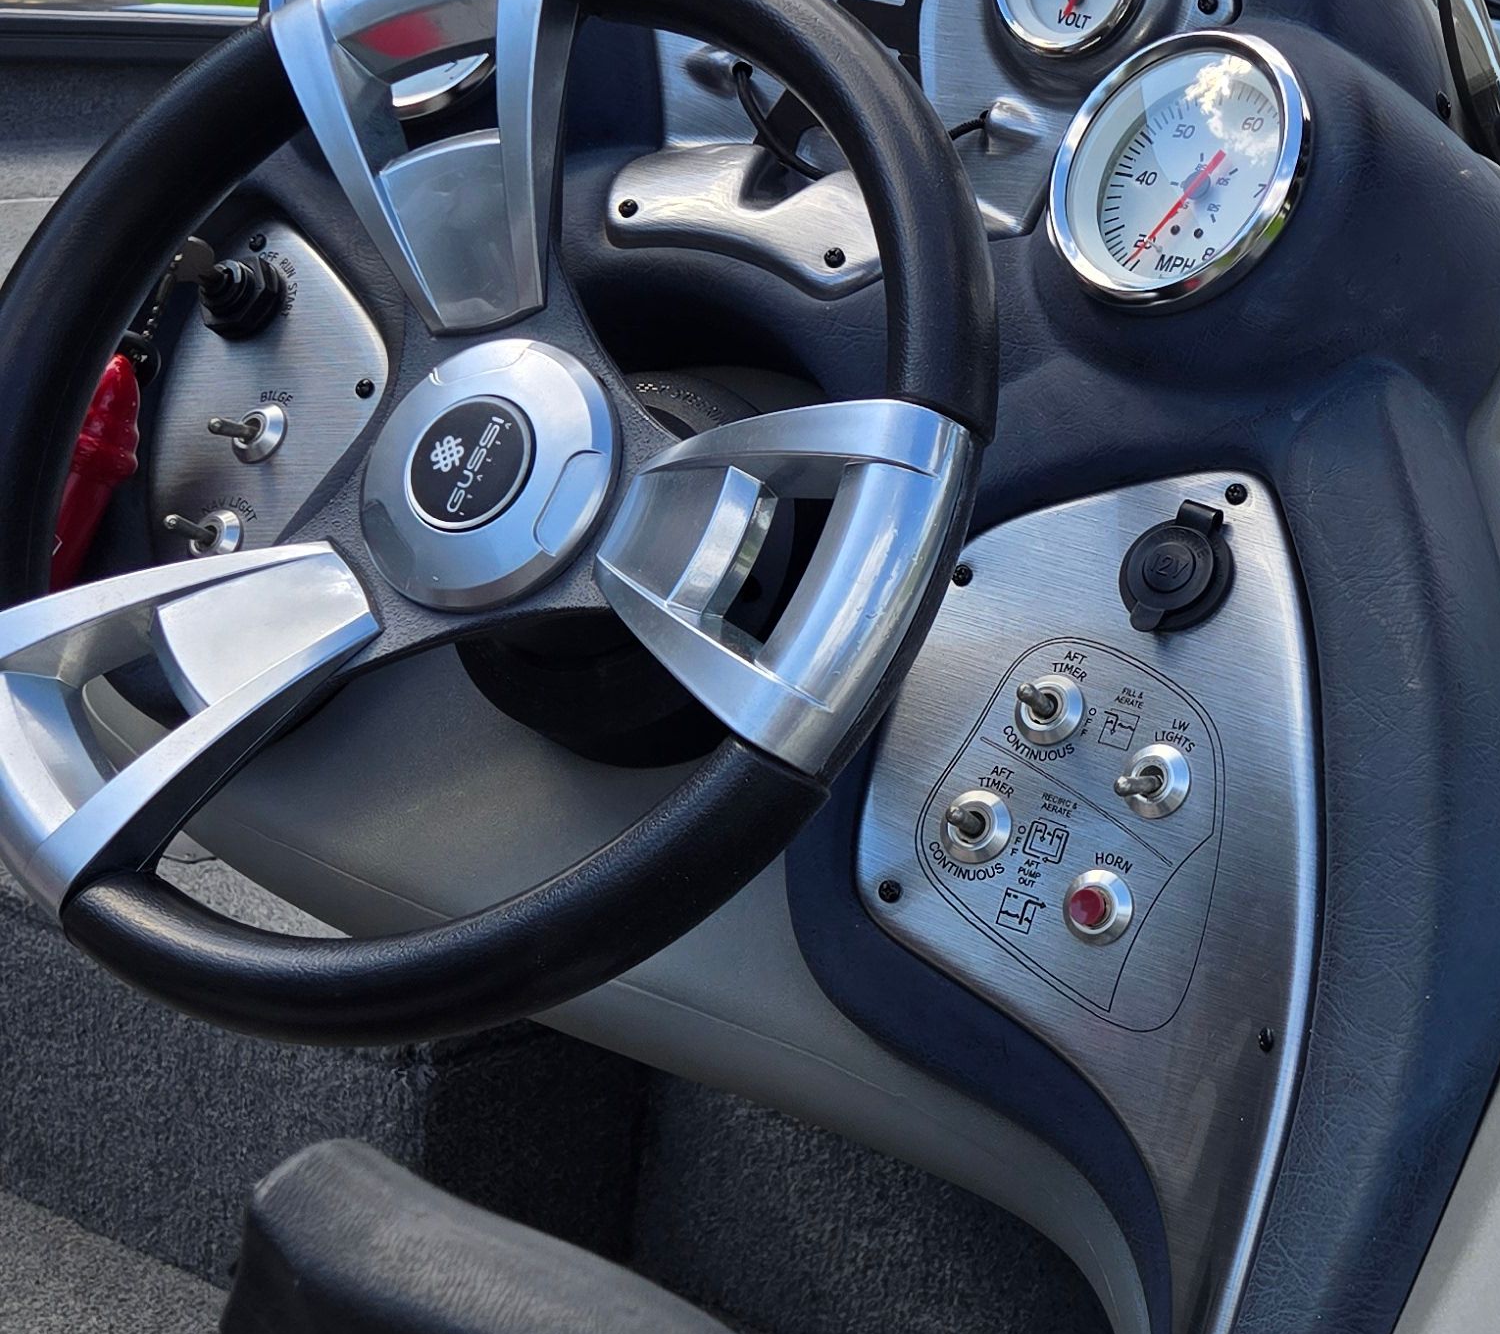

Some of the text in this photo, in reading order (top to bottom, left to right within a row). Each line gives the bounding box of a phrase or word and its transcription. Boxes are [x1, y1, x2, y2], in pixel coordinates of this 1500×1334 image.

[1057, 9, 1092, 30] VOLT
[1172, 124, 1196, 140] 50
[1241, 117, 1264, 132] 60
[1135, 171, 1158, 186] 40
[259, 251, 279, 262] OFF
[280, 258, 296, 278] RUN
[1155, 254, 1196, 274] MPH
[260, 390, 293, 407] BILGE
[446, 416, 504, 513] GUSSI
[229, 496, 257, 522] LIGHT
[1148, 552, 1190, 579] 12V
[1064, 651, 1087, 665] AFT
[1052, 662, 1088, 682] TIMER
[1122, 687, 1136, 698] FILL
[1114, 695, 1144, 709] AERATE
[1172, 718, 1191, 732] LW
[1003, 725, 1075, 761] CONTINUOUS
[1154, 730, 1196, 753] LIGHTS
[991, 765, 1015, 780] AFT
[978, 776, 1015, 799] TIMER
[1041, 803, 1074, 817] AERATE
[929, 841, 1005, 881] CONTINUOUS
[1024, 858, 1041, 869] AFT
[1095, 852, 1133, 874] HORN
[1018, 867, 1041, 879] PUMP
[1018, 877, 1036, 888] OUT
